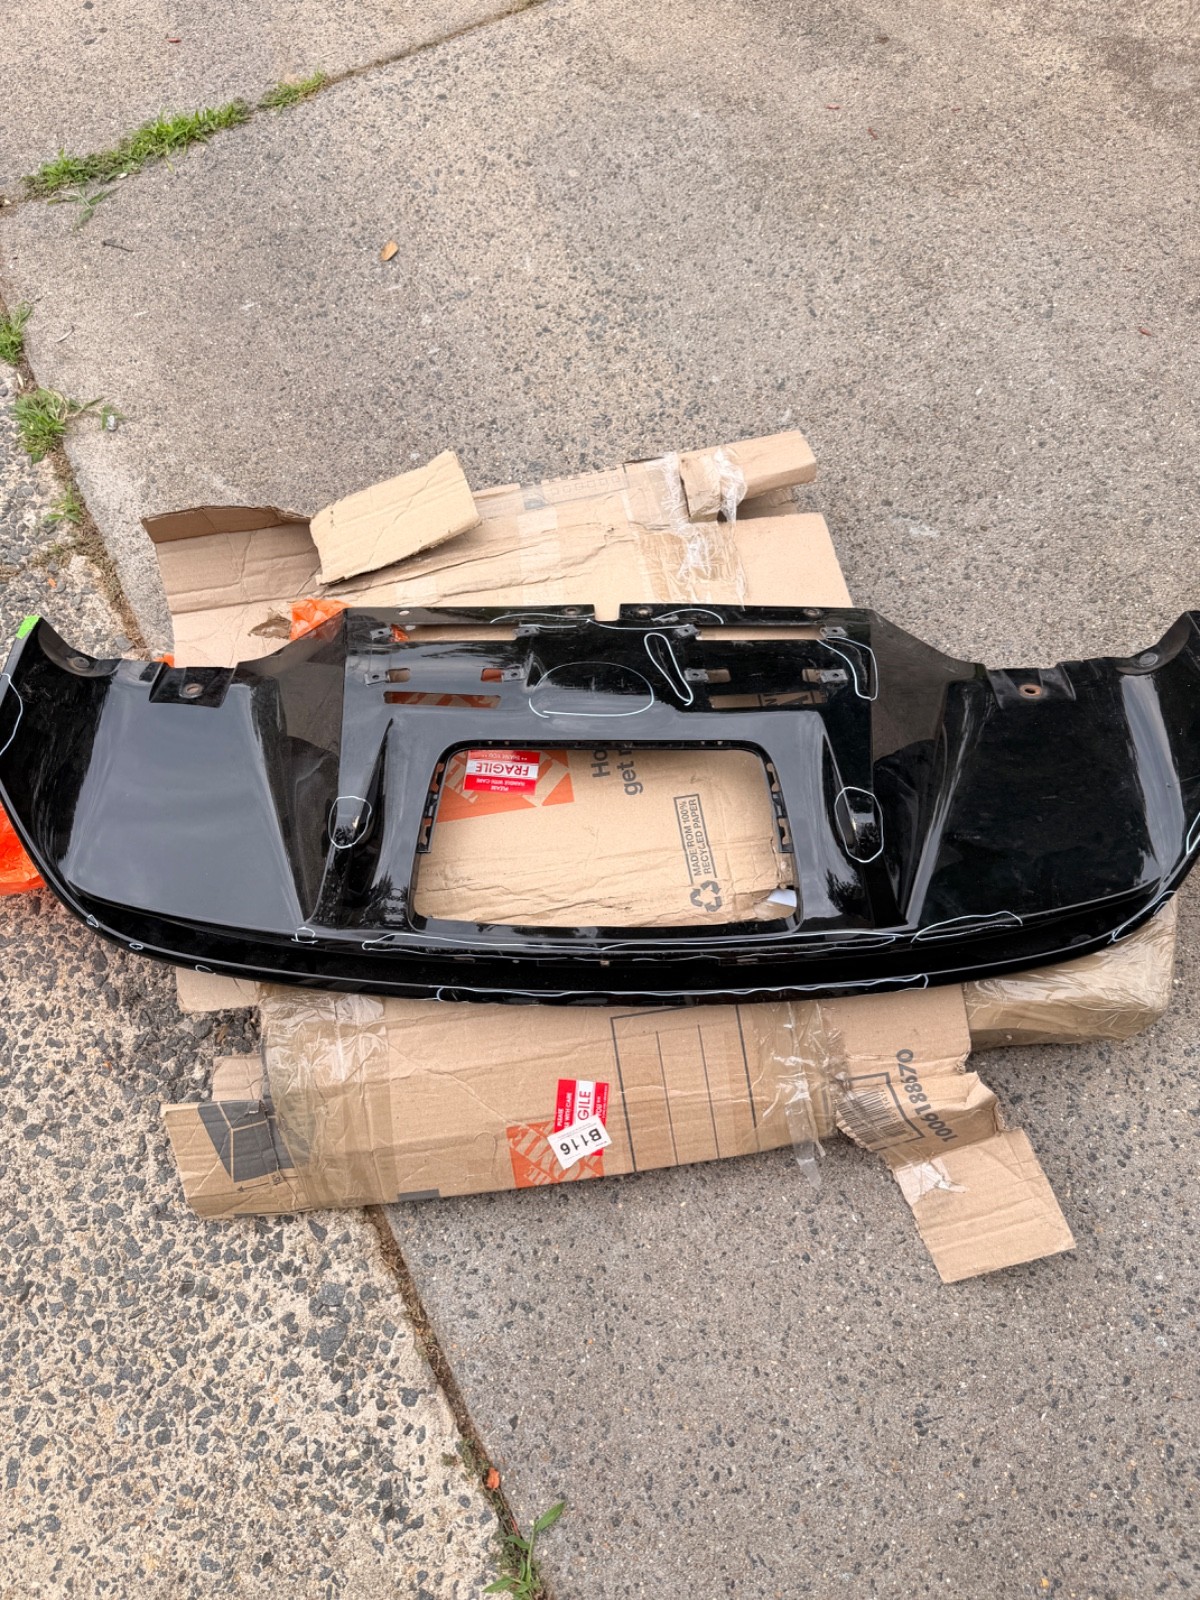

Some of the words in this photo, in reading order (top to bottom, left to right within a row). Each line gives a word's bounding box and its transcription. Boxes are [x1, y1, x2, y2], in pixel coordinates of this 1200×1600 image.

[475, 762, 530, 776] FRAGILE
[590, 748, 611, 778] Ho
[617, 760, 643, 796] get
[679, 800, 691, 824] 100%
[688, 798, 702, 829] PAPER
[683, 825, 696, 849] ROM
[688, 849, 702, 877] MADE
[577, 1090, 592, 1121] GILE
[896, 1048, 959, 1142] 1006188670
[560, 1128, 602, 1156] B116
